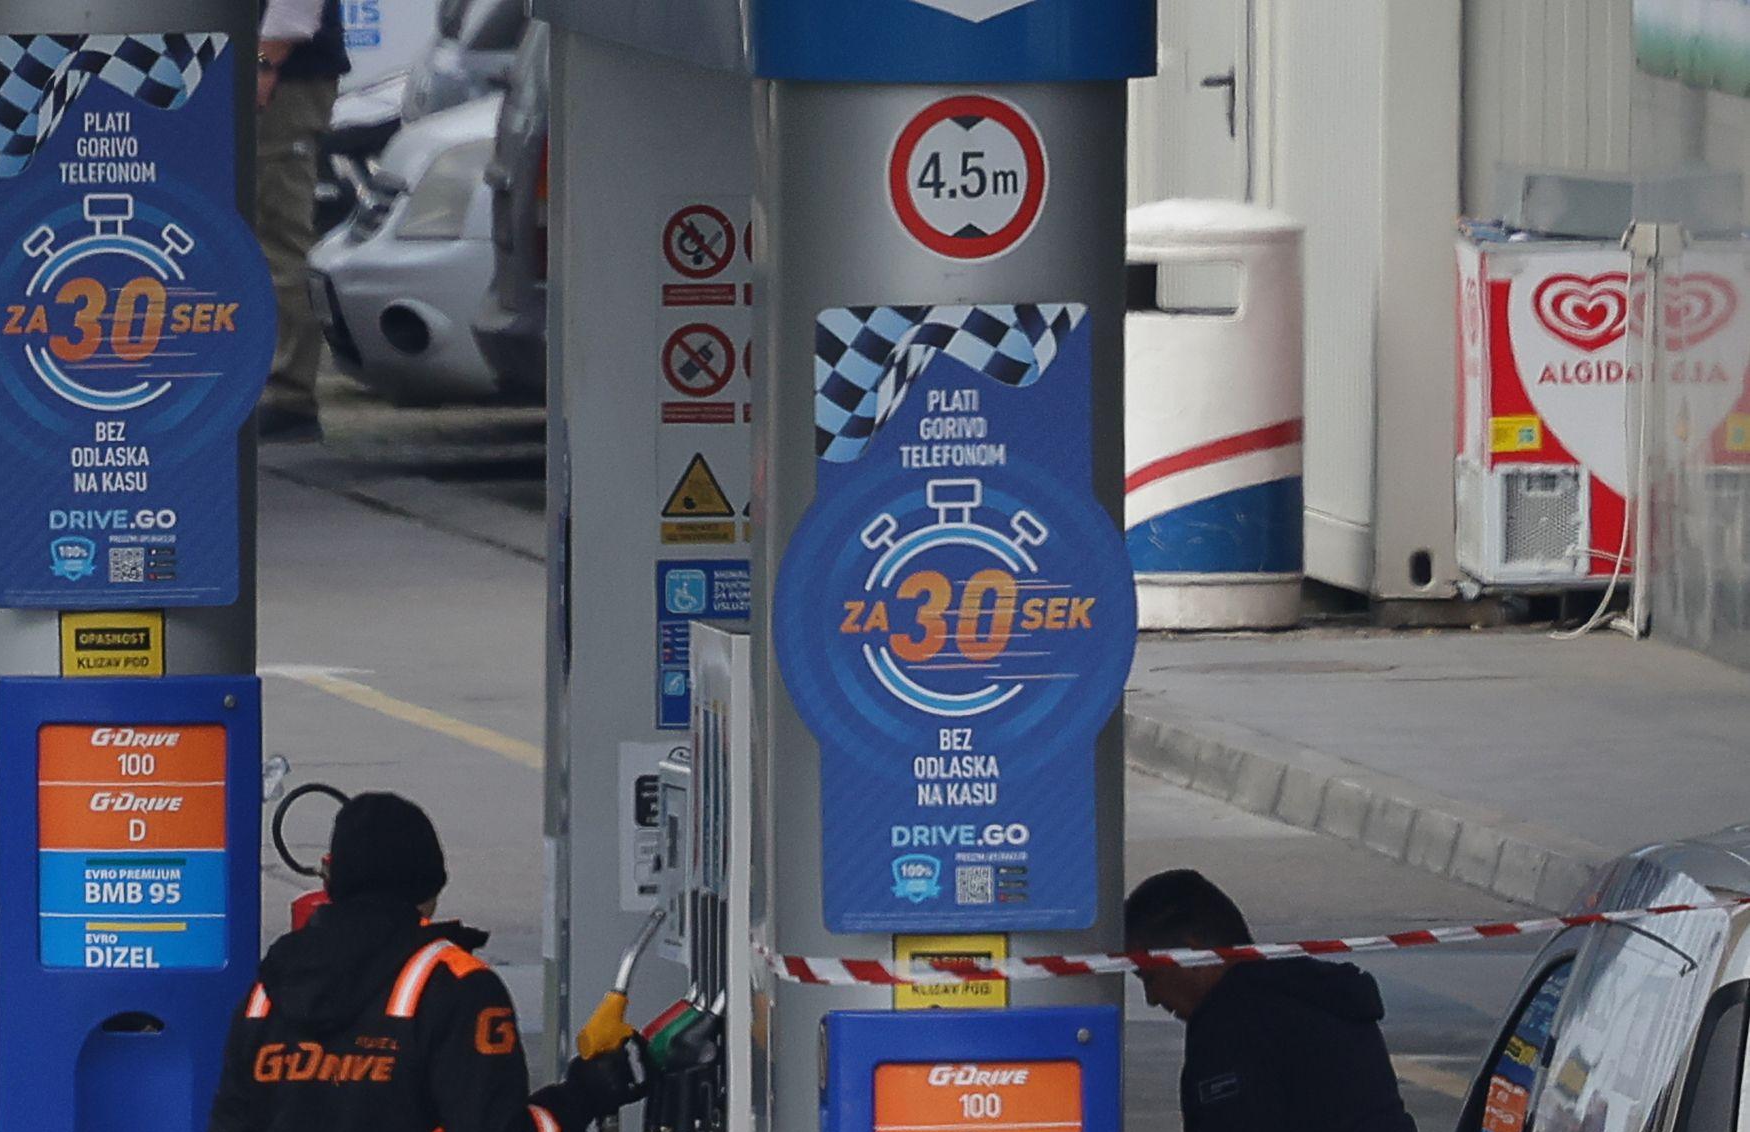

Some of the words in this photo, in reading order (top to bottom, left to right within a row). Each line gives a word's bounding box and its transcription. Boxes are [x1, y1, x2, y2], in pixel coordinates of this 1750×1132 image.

[84, 112, 130, 132] PLATI
[77, 137, 138, 157] GORIVO
[59, 162, 156, 183] TELEFONOM
[2, 305, 48, 335] ZA
[48, 277, 167, 362] 30
[170, 302, 238, 333] SEK
[927, 389, 979, 412] PLATI
[96, 421, 125, 442] BEZ
[920, 417, 987, 440] GORIVO
[71, 447, 149, 467] ODLASKA
[900, 444, 1005, 467] TELEFONOM
[74, 473, 97, 493] NA
[103, 472, 148, 492] KASU
[49, 509, 177, 530] DRIVE.GO
[840, 601, 889, 633] ZA
[889, 569, 1019, 662] 30
[1021, 597, 1096, 630] SEK
[939, 728, 972, 750] BEZ
[117, 753, 155, 775] 100
[914, 756, 999, 779] ODLASKA
[918, 783, 943, 806] NA
[947, 782, 997, 805] KASU
[128, 818, 147, 842] D
[891, 823, 1030, 847] DRIVE.GO
[85, 869, 117, 880] EVRO
[85, 882, 143, 904] BMB
[149, 882, 181, 904] 95
[85, 933, 118, 944] EVRO
[85, 946, 160, 969] DIZEL
[475, 1007, 515, 1054] G
[959, 1093, 1001, 1118] 100
